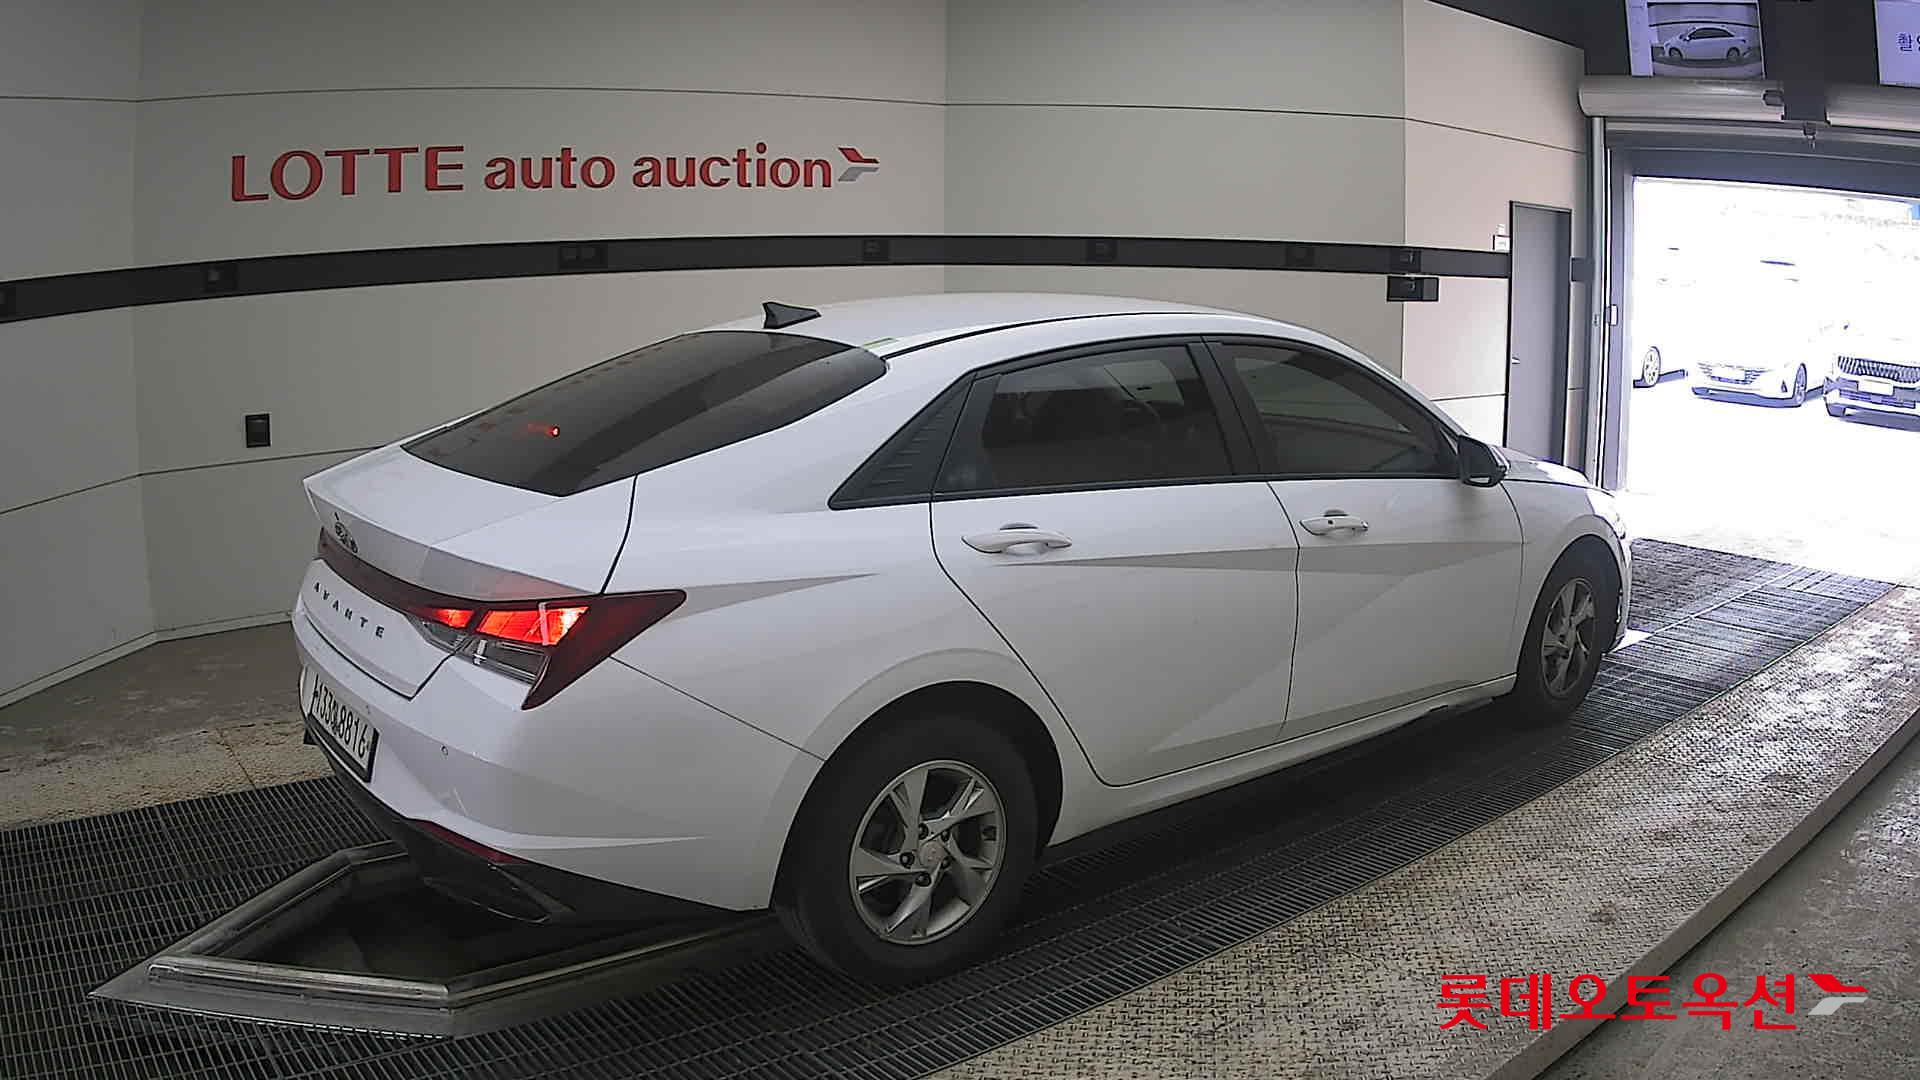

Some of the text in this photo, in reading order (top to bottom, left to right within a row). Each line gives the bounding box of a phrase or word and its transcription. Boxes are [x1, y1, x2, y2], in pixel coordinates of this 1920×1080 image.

[1897, 33, 1920, 52] 촬
[232, 143, 832, 201] LOTTE auto auction
[313, 582, 385, 638] AVANTE
